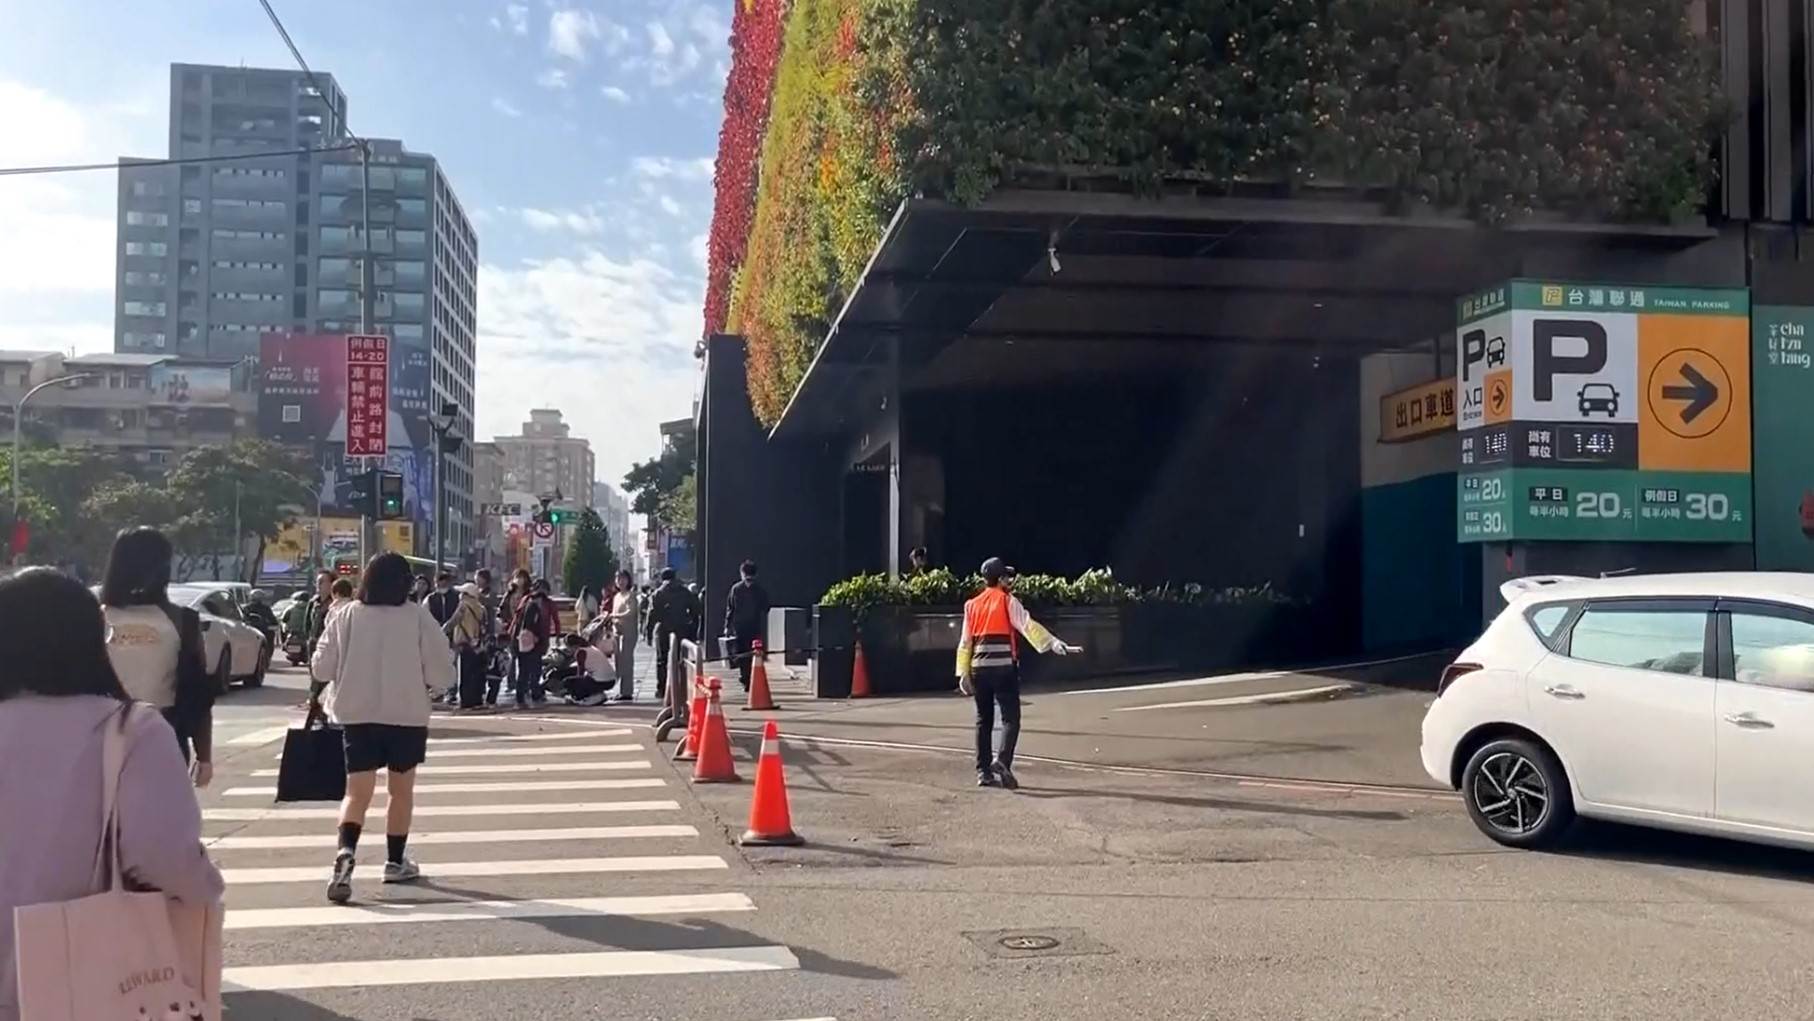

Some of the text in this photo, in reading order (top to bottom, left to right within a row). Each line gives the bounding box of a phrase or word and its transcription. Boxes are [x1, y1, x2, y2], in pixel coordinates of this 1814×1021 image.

[1567, 288, 1646, 308] 台灣聯通
[1780, 321, 1805, 336] cha
[1463, 328, 1486, 382] P
[1533, 319, 1608, 402] P
[1395, 387, 1454, 429] 出口車道
[1463, 386, 1483, 411] 入口
[1528, 430, 1551, 444] 尚有
[1573, 432, 1614, 453] 140
[1528, 445, 1551, 458] 車位
[1482, 478, 1502, 500] 20
[1534, 487, 1563, 500] 平日
[1644, 489, 1678, 502] 例假日
[1575, 492, 1632, 520] 20 元
[1685, 493, 1742, 522] 30 元
[1482, 511, 1502, 533] 30
